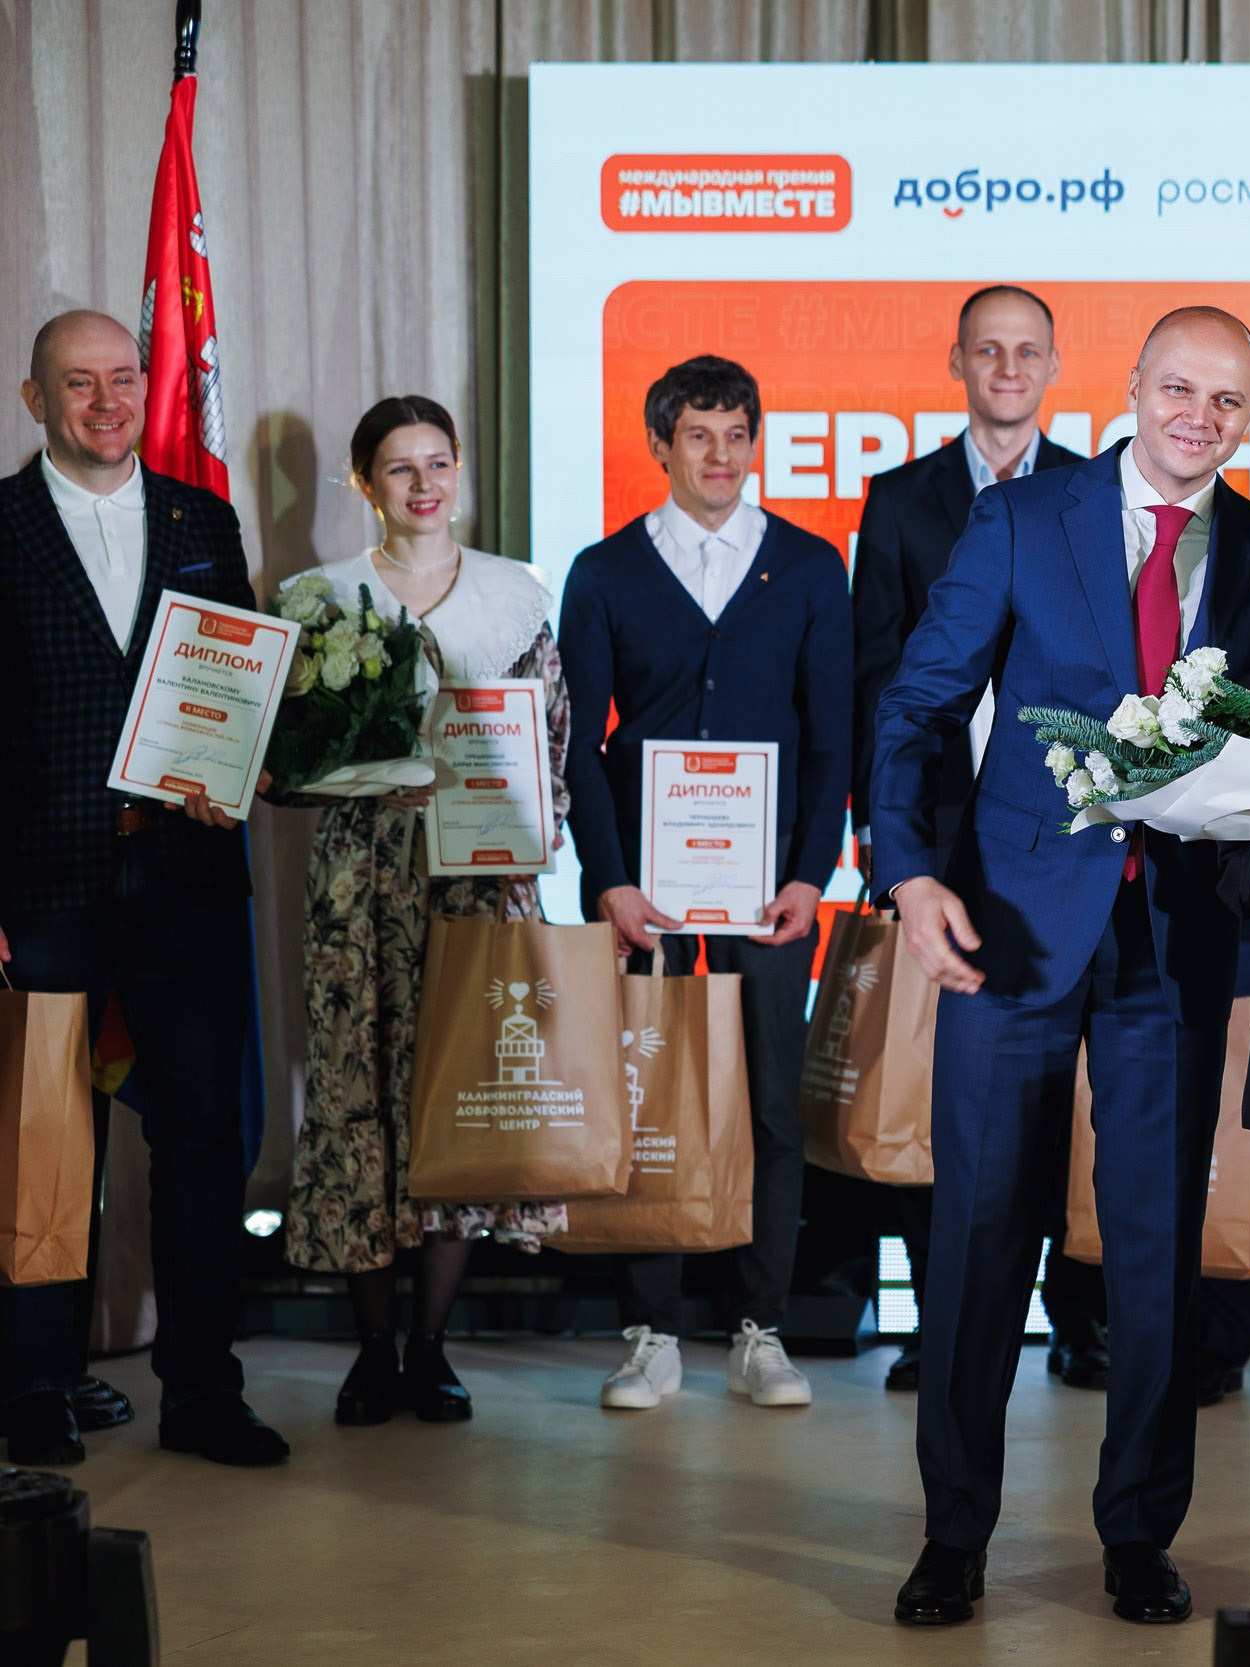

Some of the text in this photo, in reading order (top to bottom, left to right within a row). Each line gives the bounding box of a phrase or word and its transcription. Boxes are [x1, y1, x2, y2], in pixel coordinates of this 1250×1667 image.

[618, 169, 836, 190] международная премия
[896, 169, 1125, 212] добро.рф
[618, 189, 836, 217] #МЫВМЕСТЕ
[174, 642, 263, 675] ДИПЛОМ
[192, 705, 222, 721] МЕСТО
[444, 722, 522, 739] ДИПЛОМ
[667, 783, 752, 799] ДИПЛОМ
[457, 1087, 584, 1102] КАЛИНИНГРАДСКИЙ
[455, 1103, 585, 1117] ДОБРОВОЛЬЧЕСКИЙ
[499, 1119, 541, 1131] ЦЕНТР
